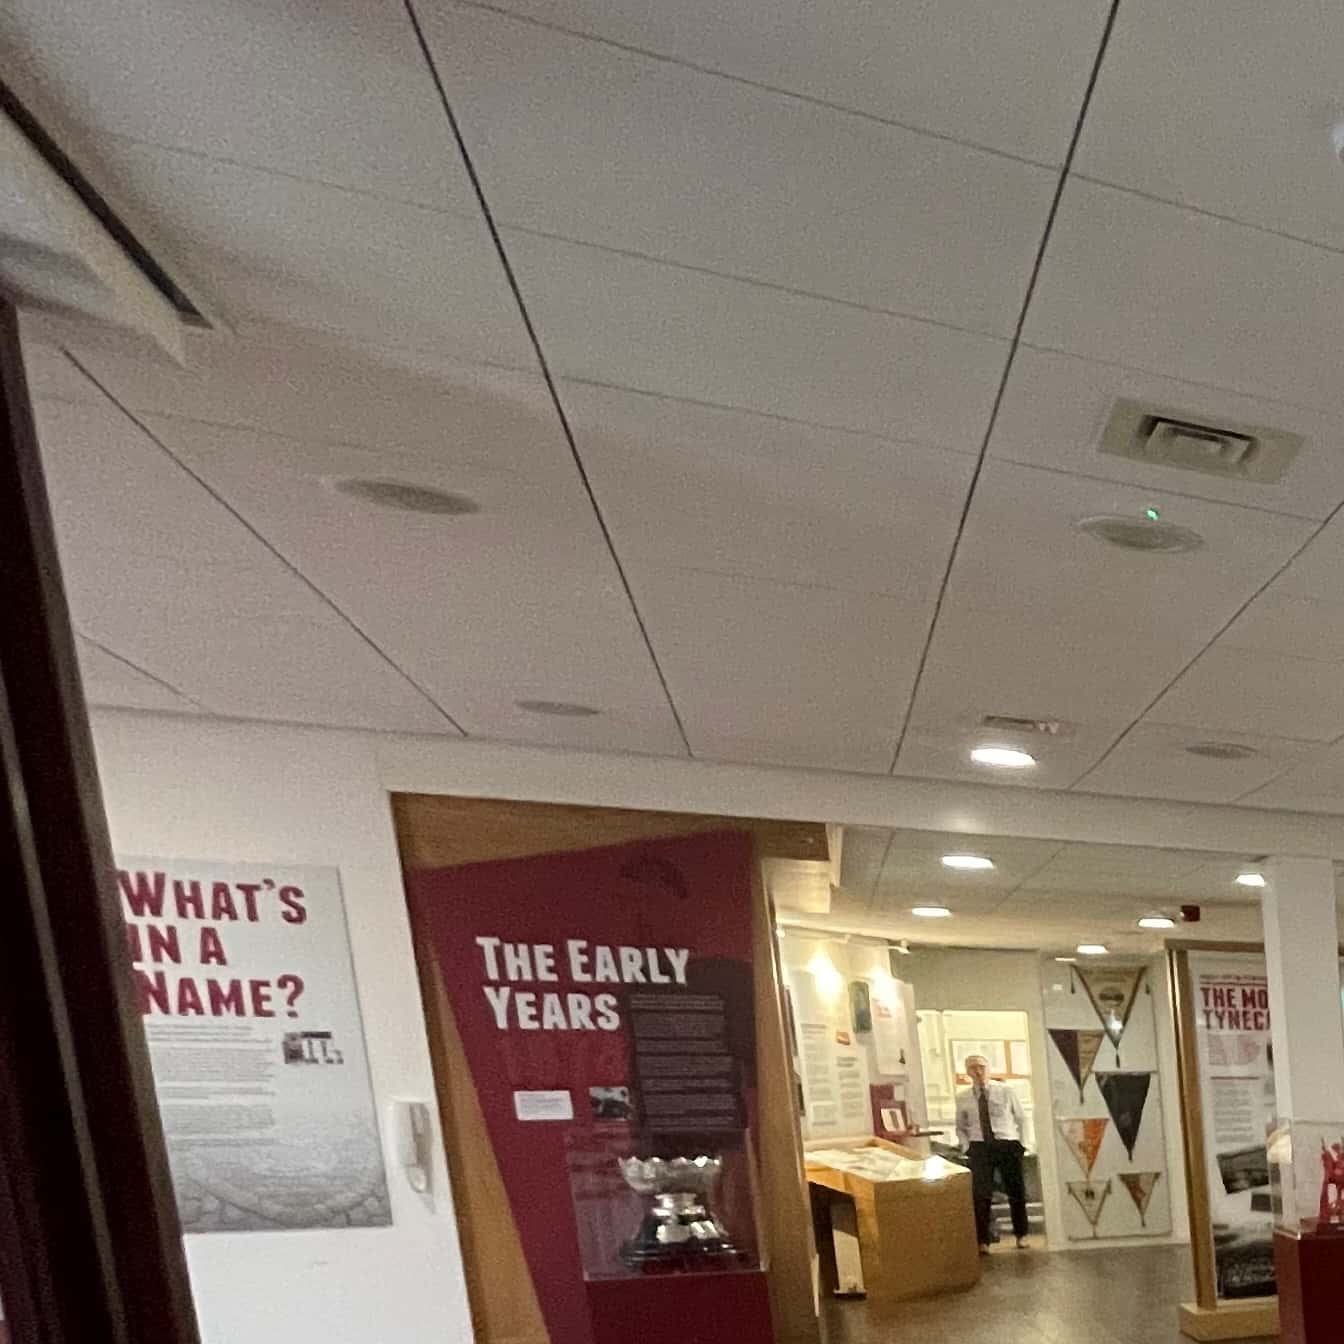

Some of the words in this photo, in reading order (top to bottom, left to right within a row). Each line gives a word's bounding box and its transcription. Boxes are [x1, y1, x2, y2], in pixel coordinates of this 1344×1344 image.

[117, 869, 307, 925] WHAT'S
[127, 923, 182, 964] IN
[200, 926, 227, 966] A
[476, 936, 559, 982] THE
[567, 939, 690, 984] EARLY
[133, 969, 304, 1018] NAME?
[482, 986, 620, 1030] YEARS
[1200, 987, 1236, 1008] THE
